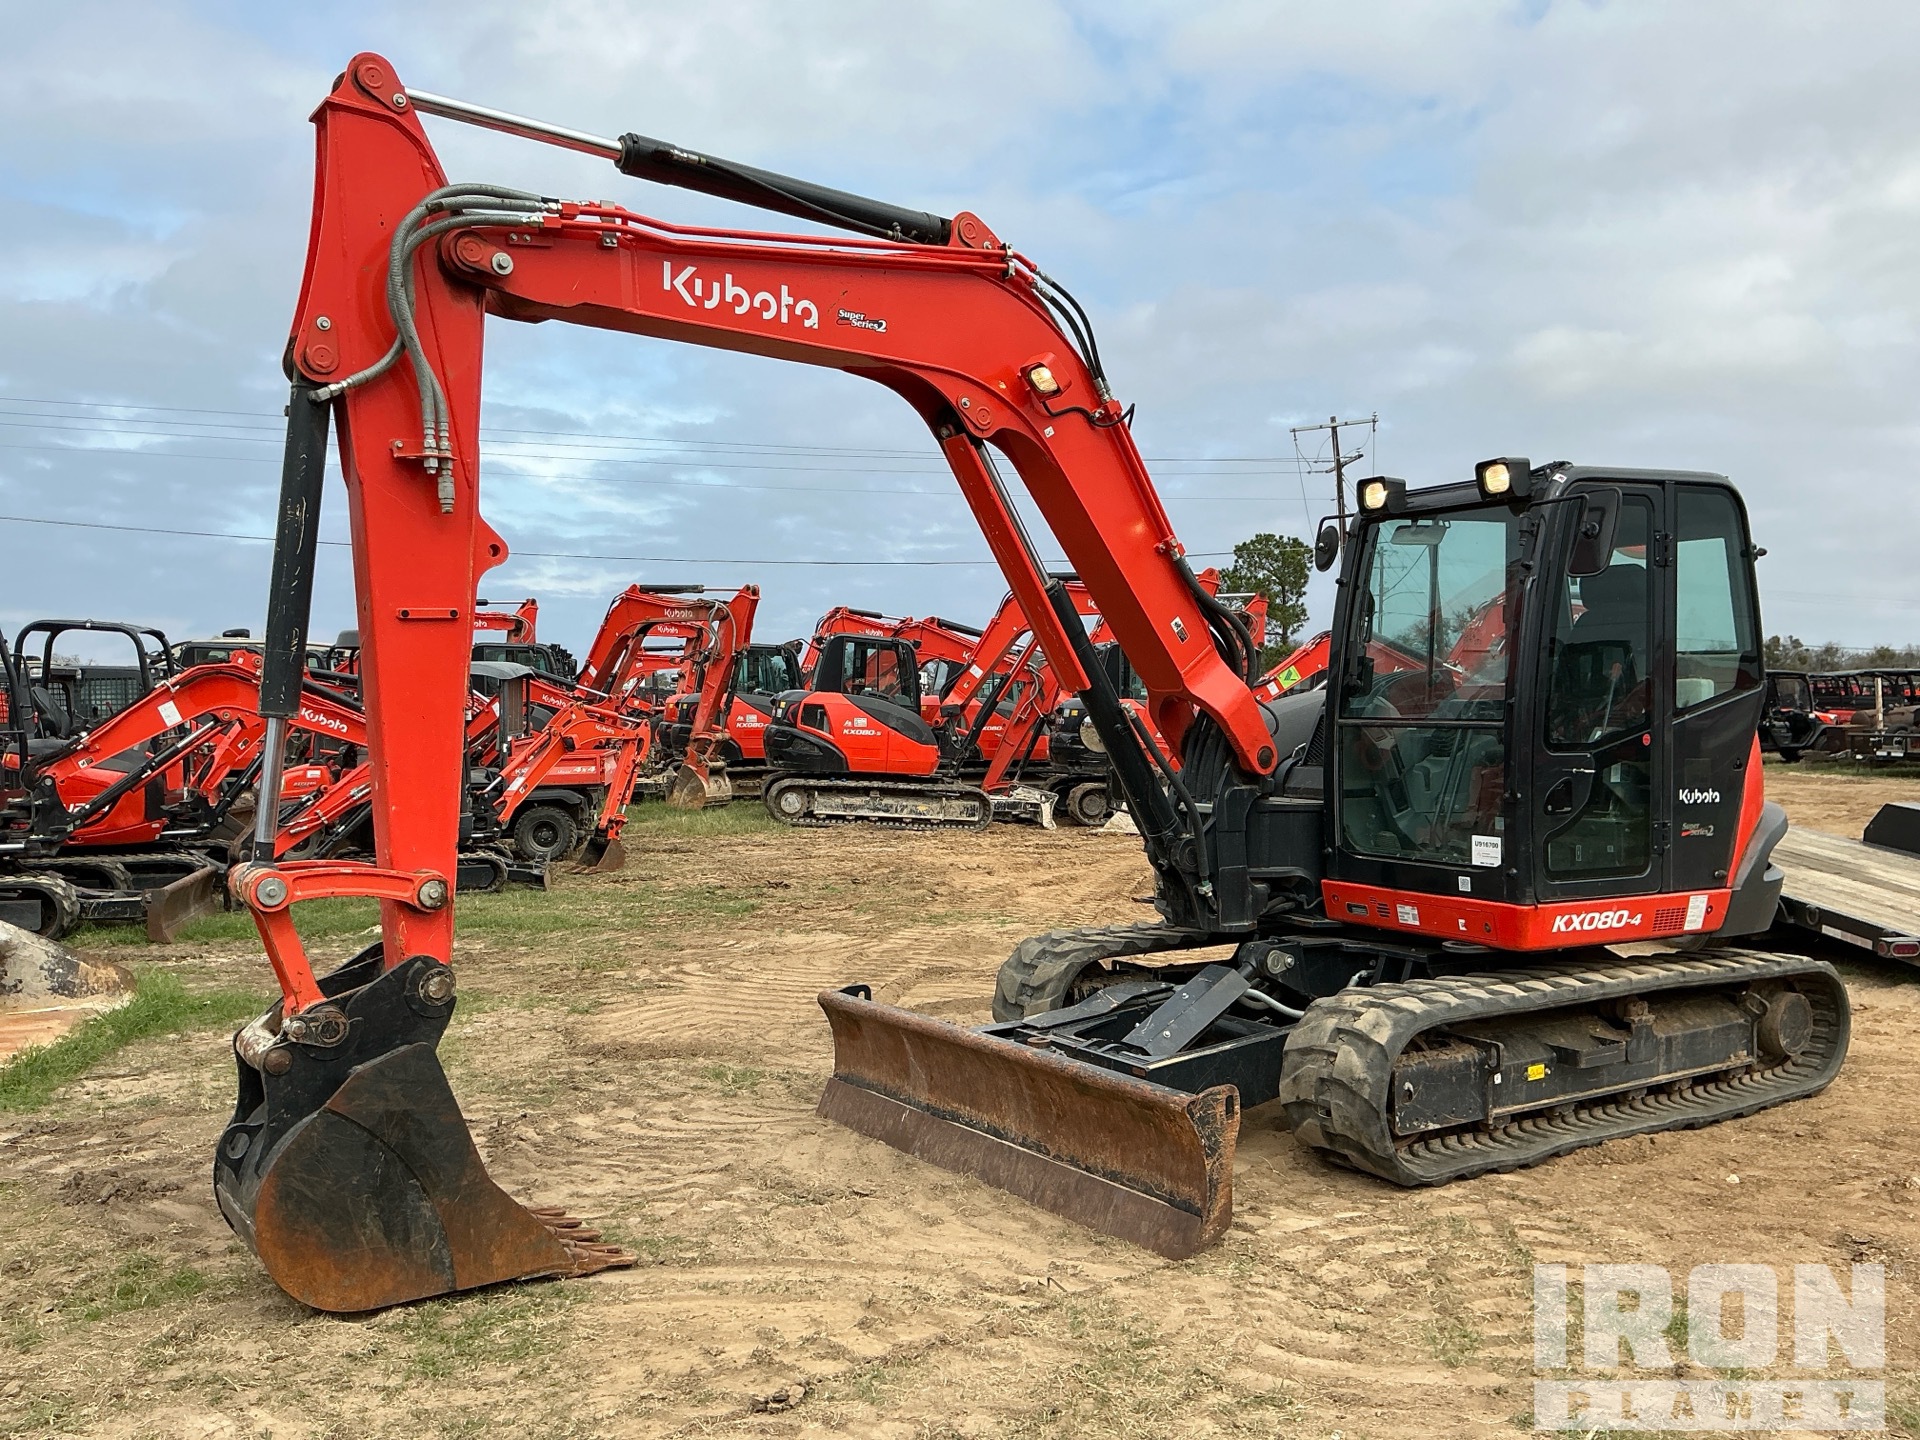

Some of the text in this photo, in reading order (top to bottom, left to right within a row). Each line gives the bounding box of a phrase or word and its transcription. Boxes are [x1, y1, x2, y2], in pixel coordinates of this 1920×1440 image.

[663, 261, 819, 329] Kubota
[838, 309, 865, 321] Super
[664, 608, 693, 618] Kubota
[657, 625, 679, 634] Kubota
[300, 707, 348, 733] Kubota
[1679, 788, 1720, 804] Kubota
[1551, 909, 1643, 933] KX080-4
